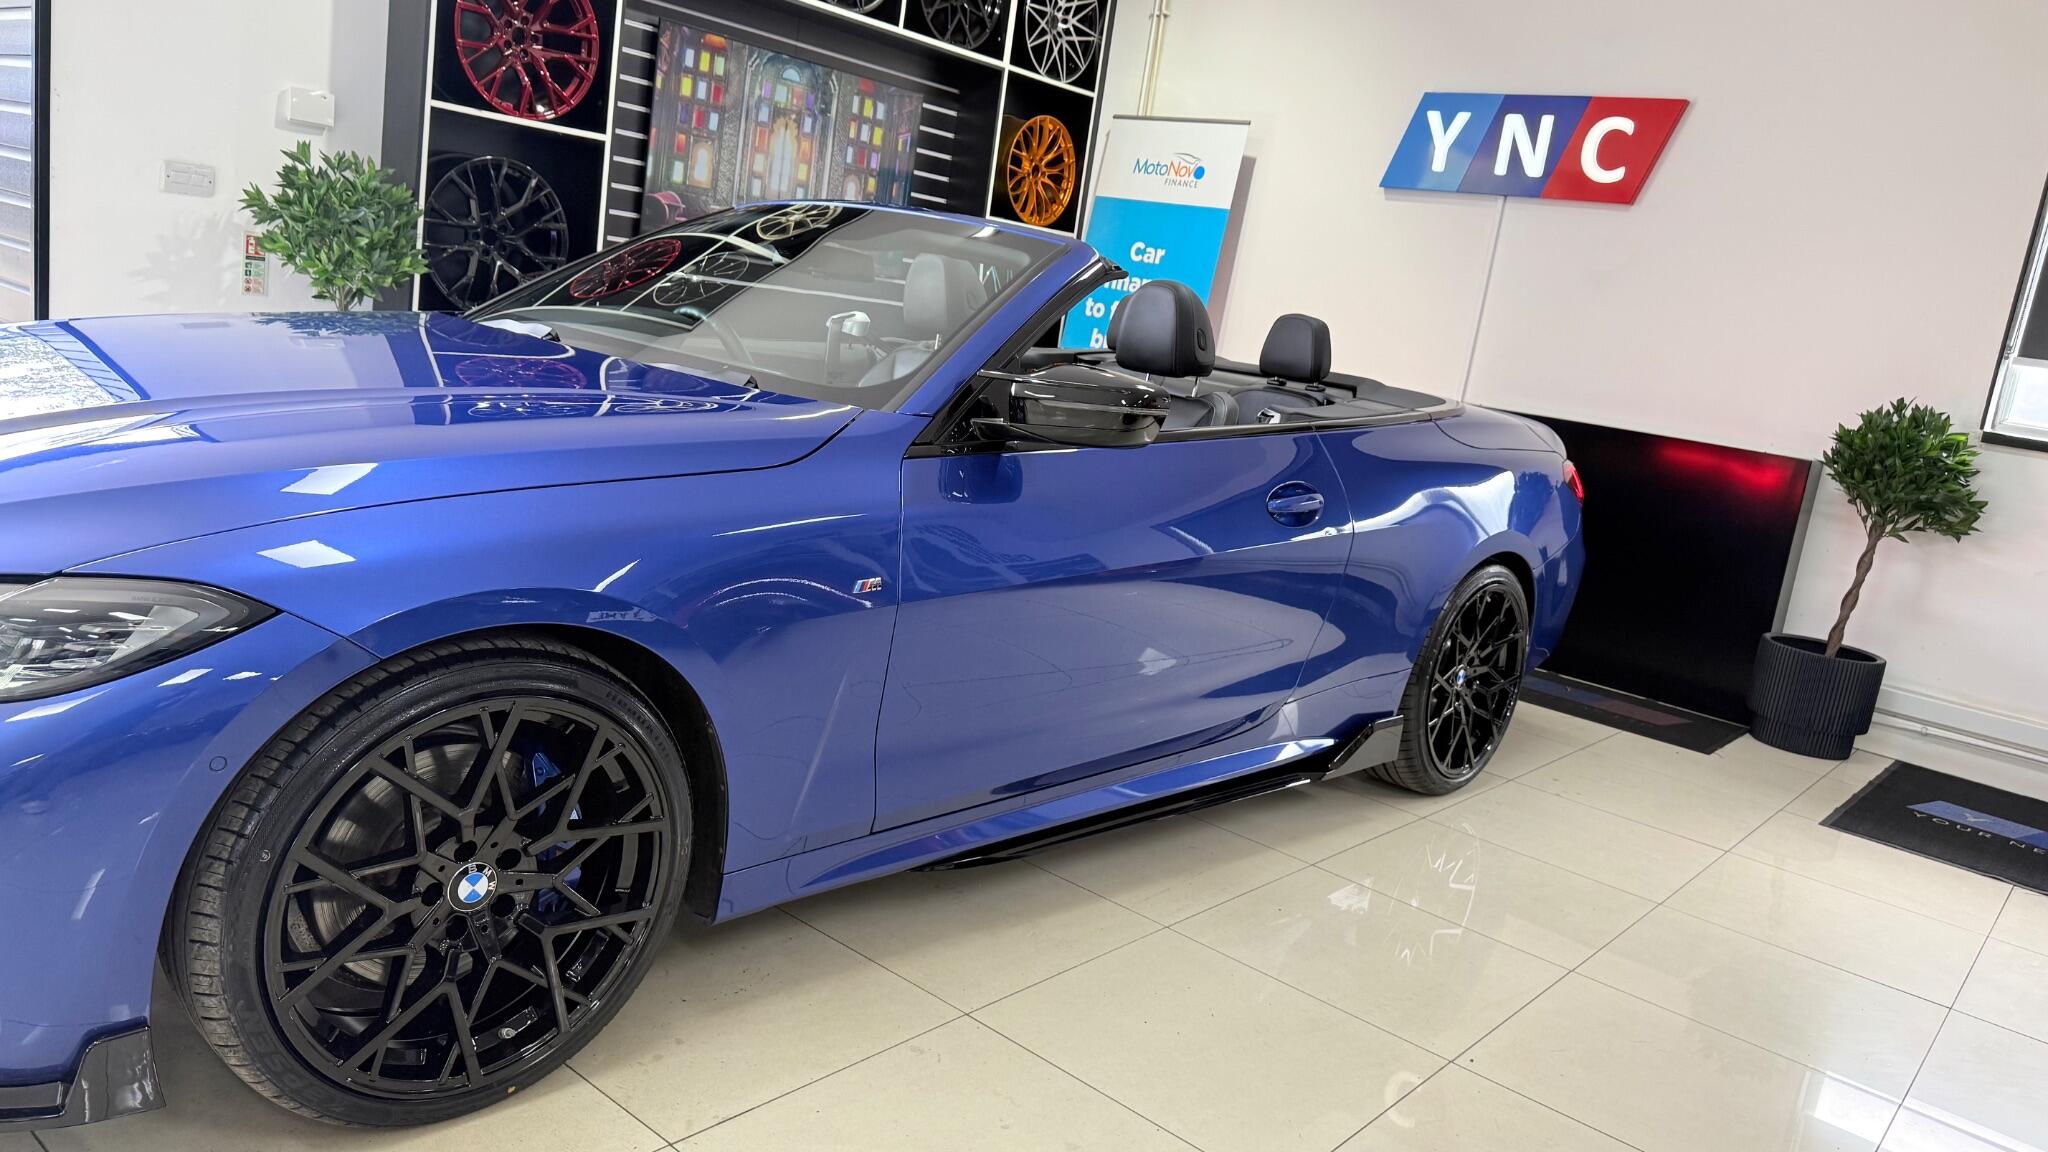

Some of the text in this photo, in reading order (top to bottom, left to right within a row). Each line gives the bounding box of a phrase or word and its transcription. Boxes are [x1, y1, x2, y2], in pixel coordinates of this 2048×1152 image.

[1426, 110, 1635, 184] YNC
[1133, 158, 1205, 180] MotoNovo
[1164, 178, 1199, 189] FINANCE
[1130, 241, 1166, 265] Car
[1085, 297, 1105, 318] to
[1913, 811, 2047, 855] YOUR NE
[468, 864, 496, 890] BMW
